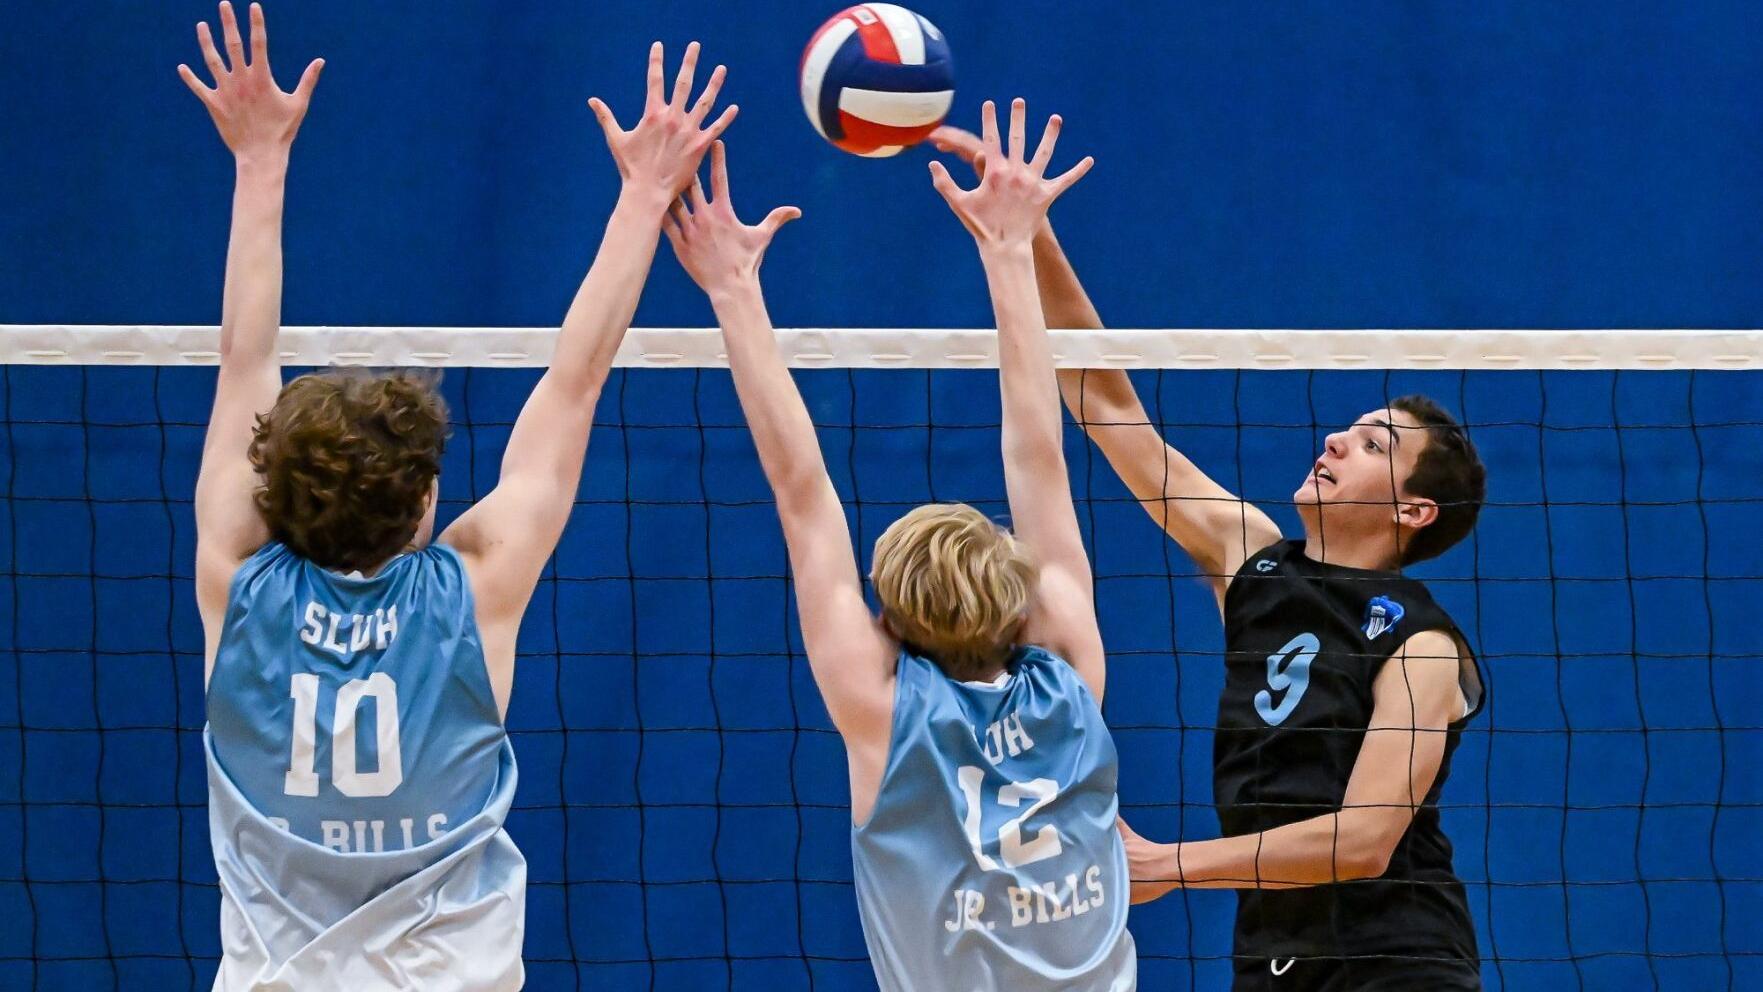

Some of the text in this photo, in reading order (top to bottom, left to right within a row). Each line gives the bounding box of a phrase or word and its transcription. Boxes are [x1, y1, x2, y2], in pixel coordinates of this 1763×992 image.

[300, 601, 399, 654] SLUH
[1254, 632, 1321, 726] 9
[284, 672, 403, 798] 10
[957, 765, 1063, 872] 12
[1007, 865, 1106, 928] BILLS
